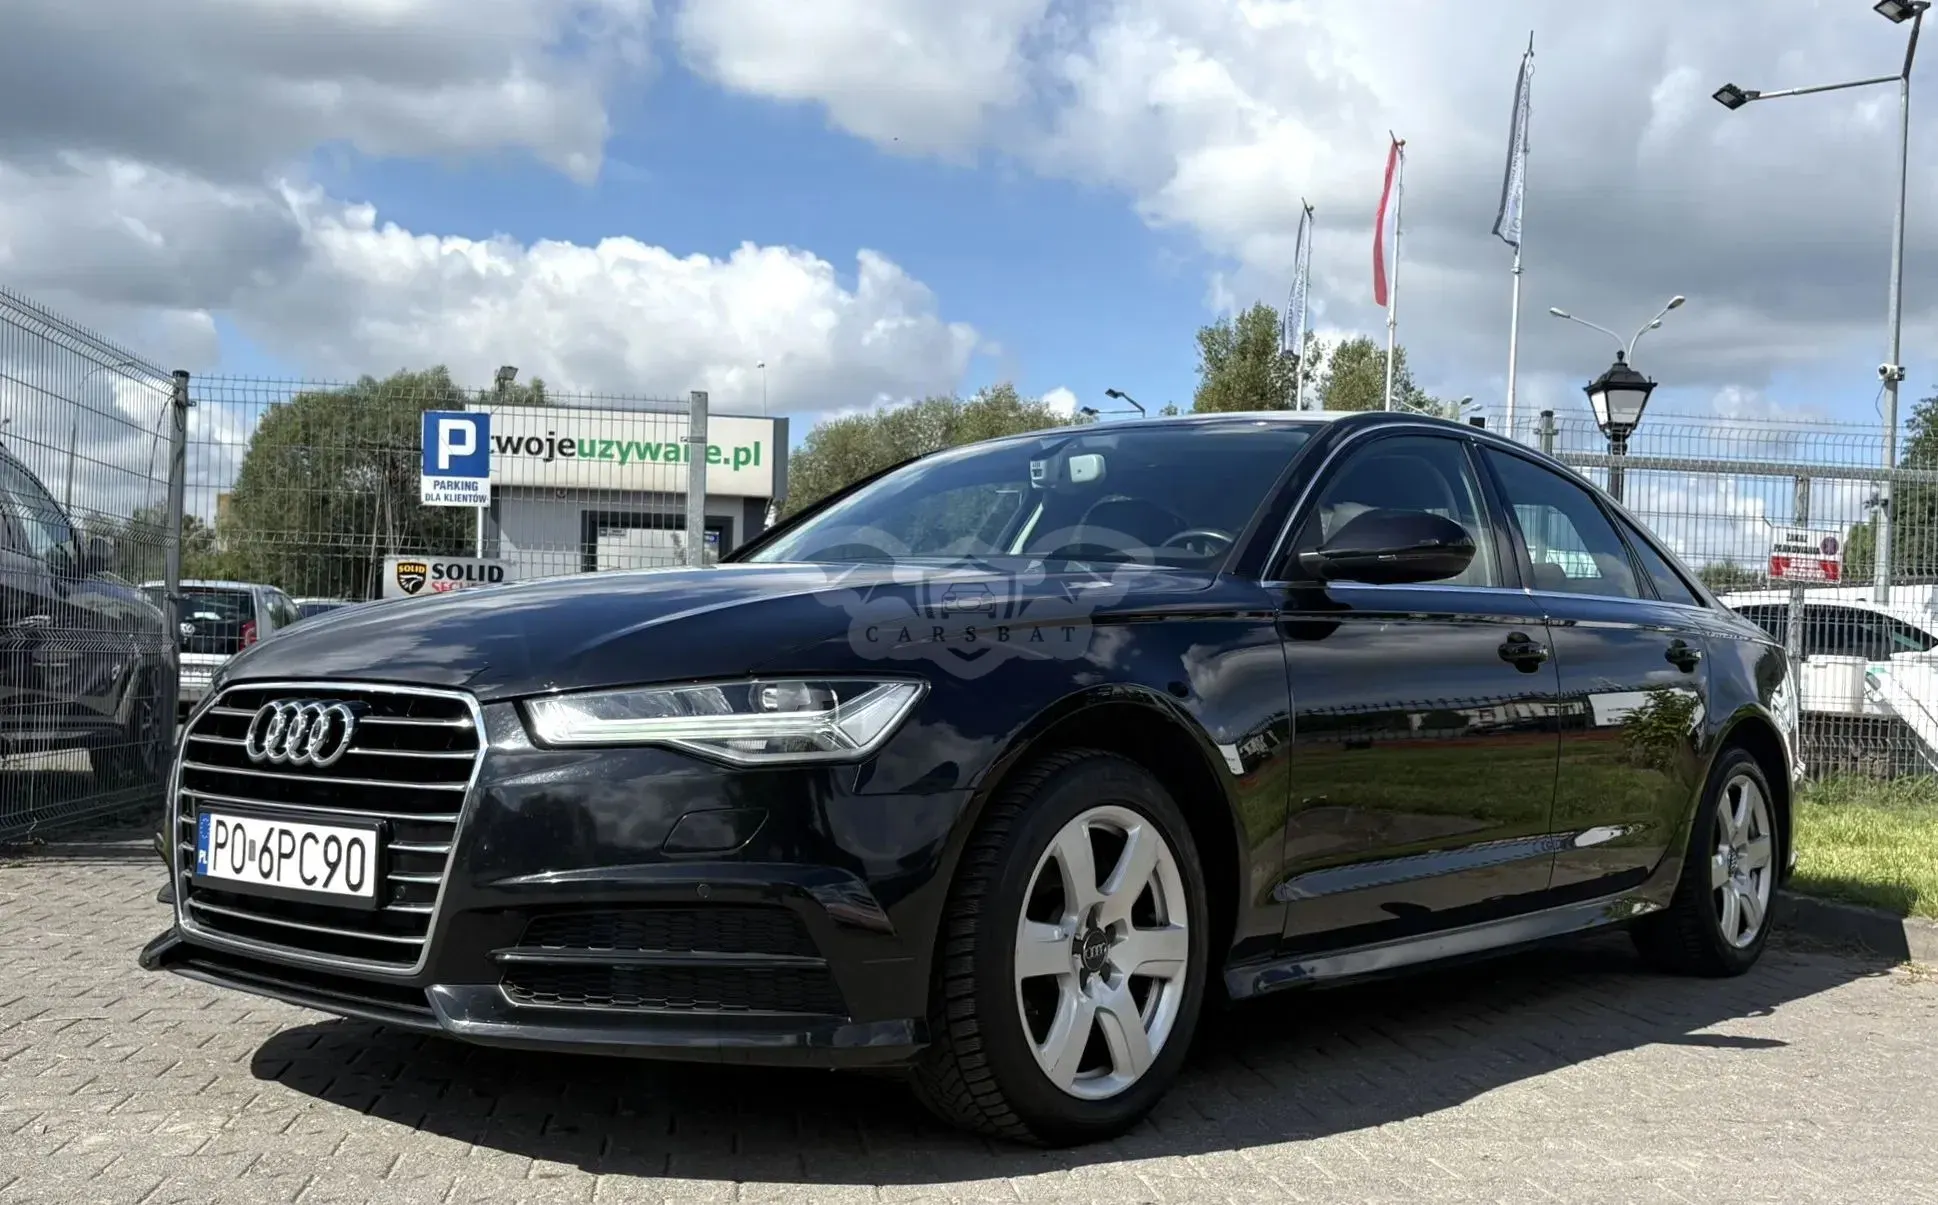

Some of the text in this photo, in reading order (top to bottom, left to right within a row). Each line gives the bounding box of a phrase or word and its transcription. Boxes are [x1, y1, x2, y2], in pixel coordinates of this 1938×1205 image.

[438, 419, 477, 470] P
[433, 480, 479, 492] PARKING
[425, 492, 488, 504] DLA KLIENTÓW
[398, 564, 426, 574] SOLID
[431, 563, 505, 584] SOLID
[198, 849, 208, 865] PL
[258, 826, 366, 893] 6PC90
